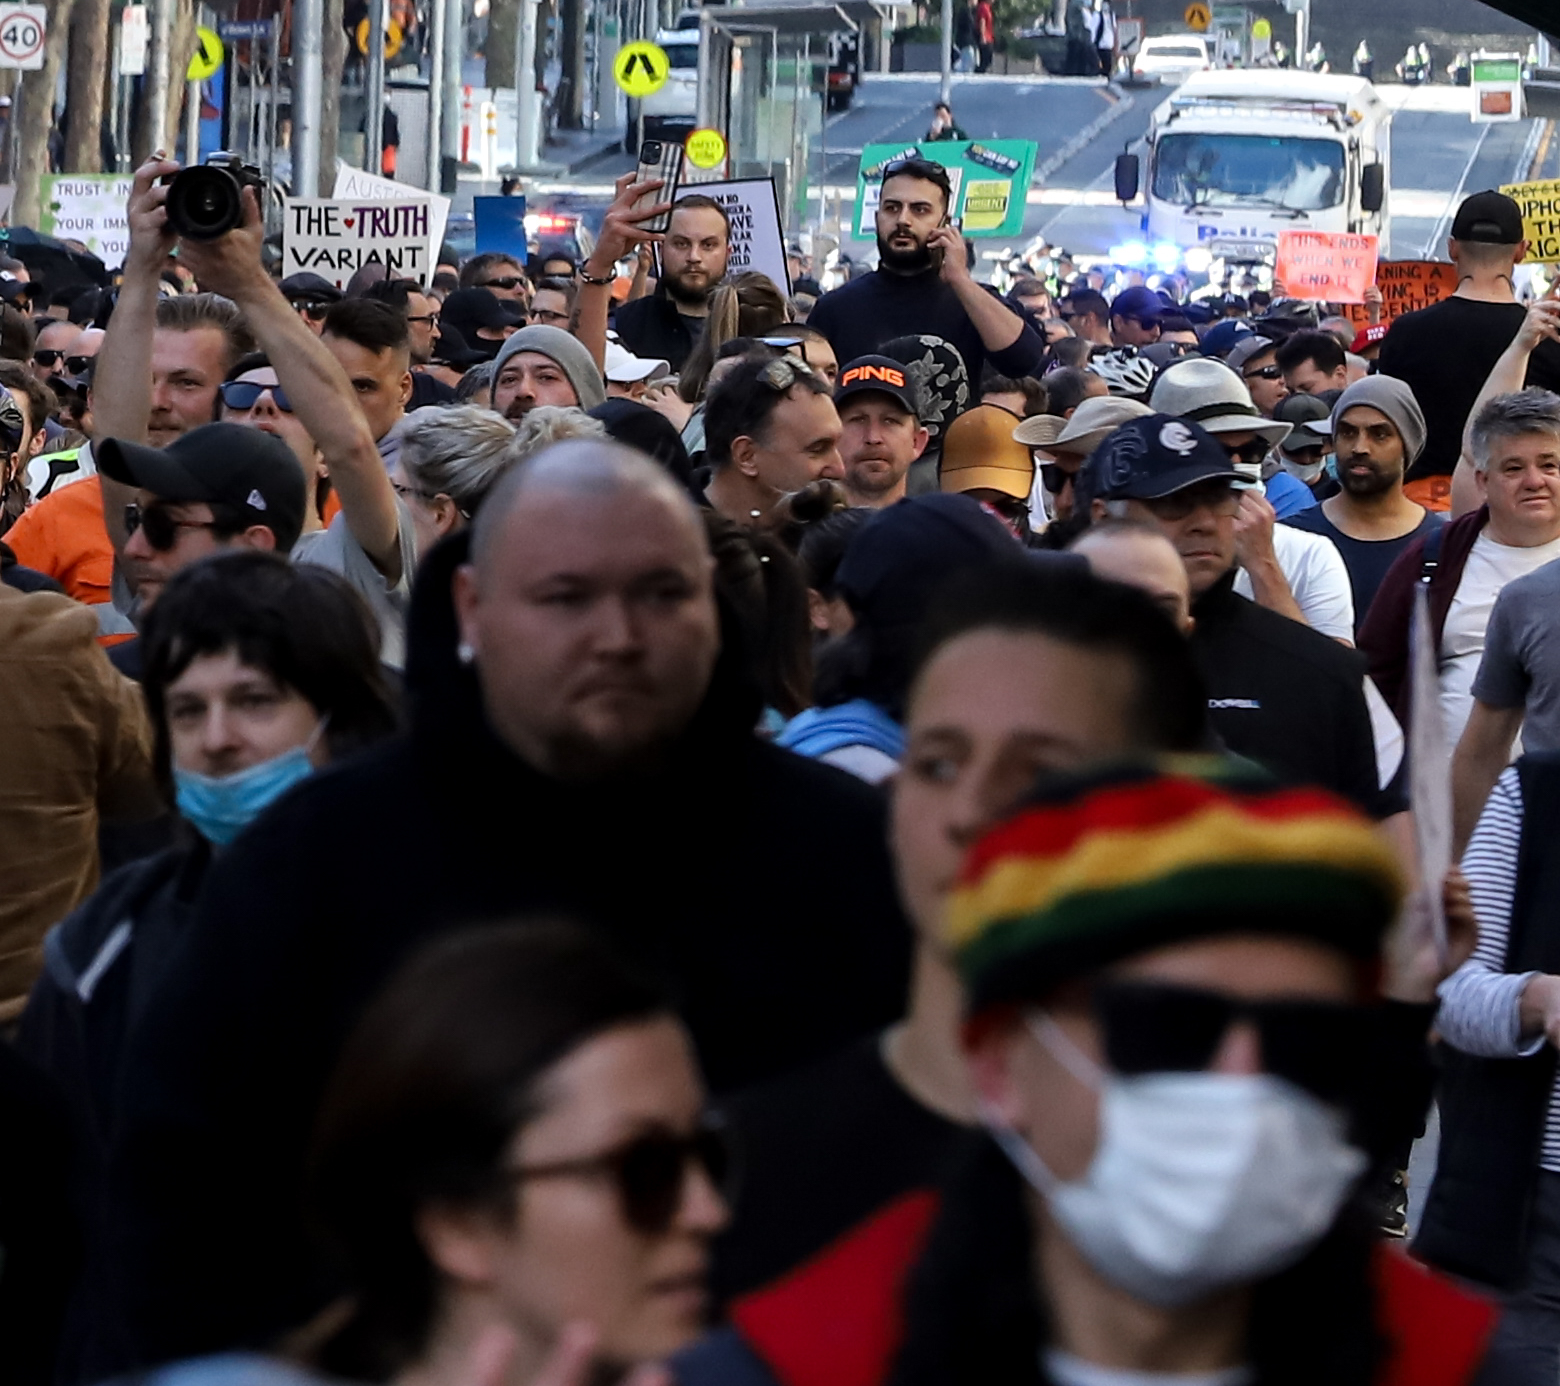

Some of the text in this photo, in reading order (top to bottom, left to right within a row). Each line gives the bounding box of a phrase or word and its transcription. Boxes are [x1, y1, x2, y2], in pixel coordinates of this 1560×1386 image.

[3, 26, 38, 47] 40
[58, 183, 100, 196] TRUST
[58, 218, 94, 230] YOUR
[290, 204, 428, 238] THE TRUTH
[1291, 234, 1369, 250] THIS ENDS
[290, 247, 424, 271] VARIANT
[728, 255, 751, 266] HILD
[1293, 255, 1364, 269] WHEN WE
[1431, 266, 1442, 279] A
[1300, 274, 1329, 287] END
[1424, 281, 1439, 296] IS
[842, 364, 906, 387] PING
